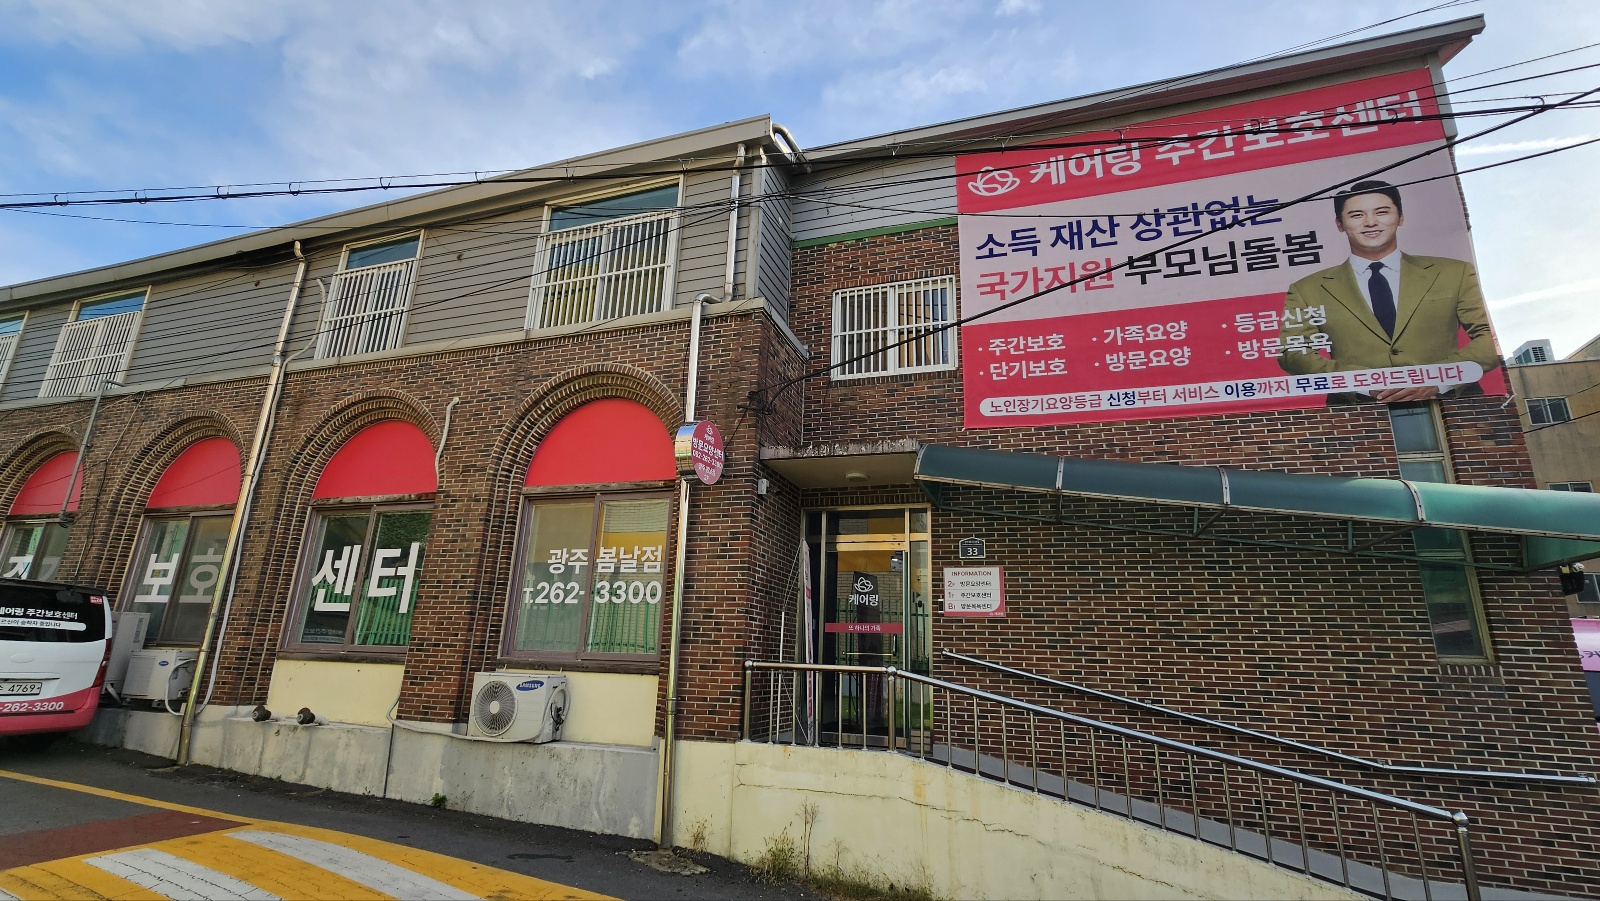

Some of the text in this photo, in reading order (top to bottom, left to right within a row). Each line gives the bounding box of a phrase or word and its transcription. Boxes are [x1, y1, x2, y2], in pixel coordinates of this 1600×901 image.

[1029, 90, 1424, 186] 케어링 주간보호센터
[975, 194, 1283, 260] 소득 재산 상관없는
[976, 230, 1324, 301] 국가지원 부모님돌봄
[1103, 320, 1188, 346] 가족요양
[1233, 304, 1328, 334] 등급신청
[988, 333, 1066, 356] 주간보호
[1105, 345, 1192, 372] 방문요양
[1237, 332, 1333, 361] 방문목욕
[989, 357, 1068, 382] 단기보호
[989, 364, 1464, 414] 노인장기요양등급 신청부터 서비스 이용까지 무료로 도와드립니다
[692, 436, 723, 460] 방문요양센터
[547, 545, 663, 575] 광주 봄날점
[966, 547, 978, 556] 33
[134, 548, 222, 603] 보호
[311, 541, 420, 614] 센터
[26, 608, 78, 620] 주간보호센터
[848, 593, 879, 607] 케어링
[8, 684, 36, 693] 4769
